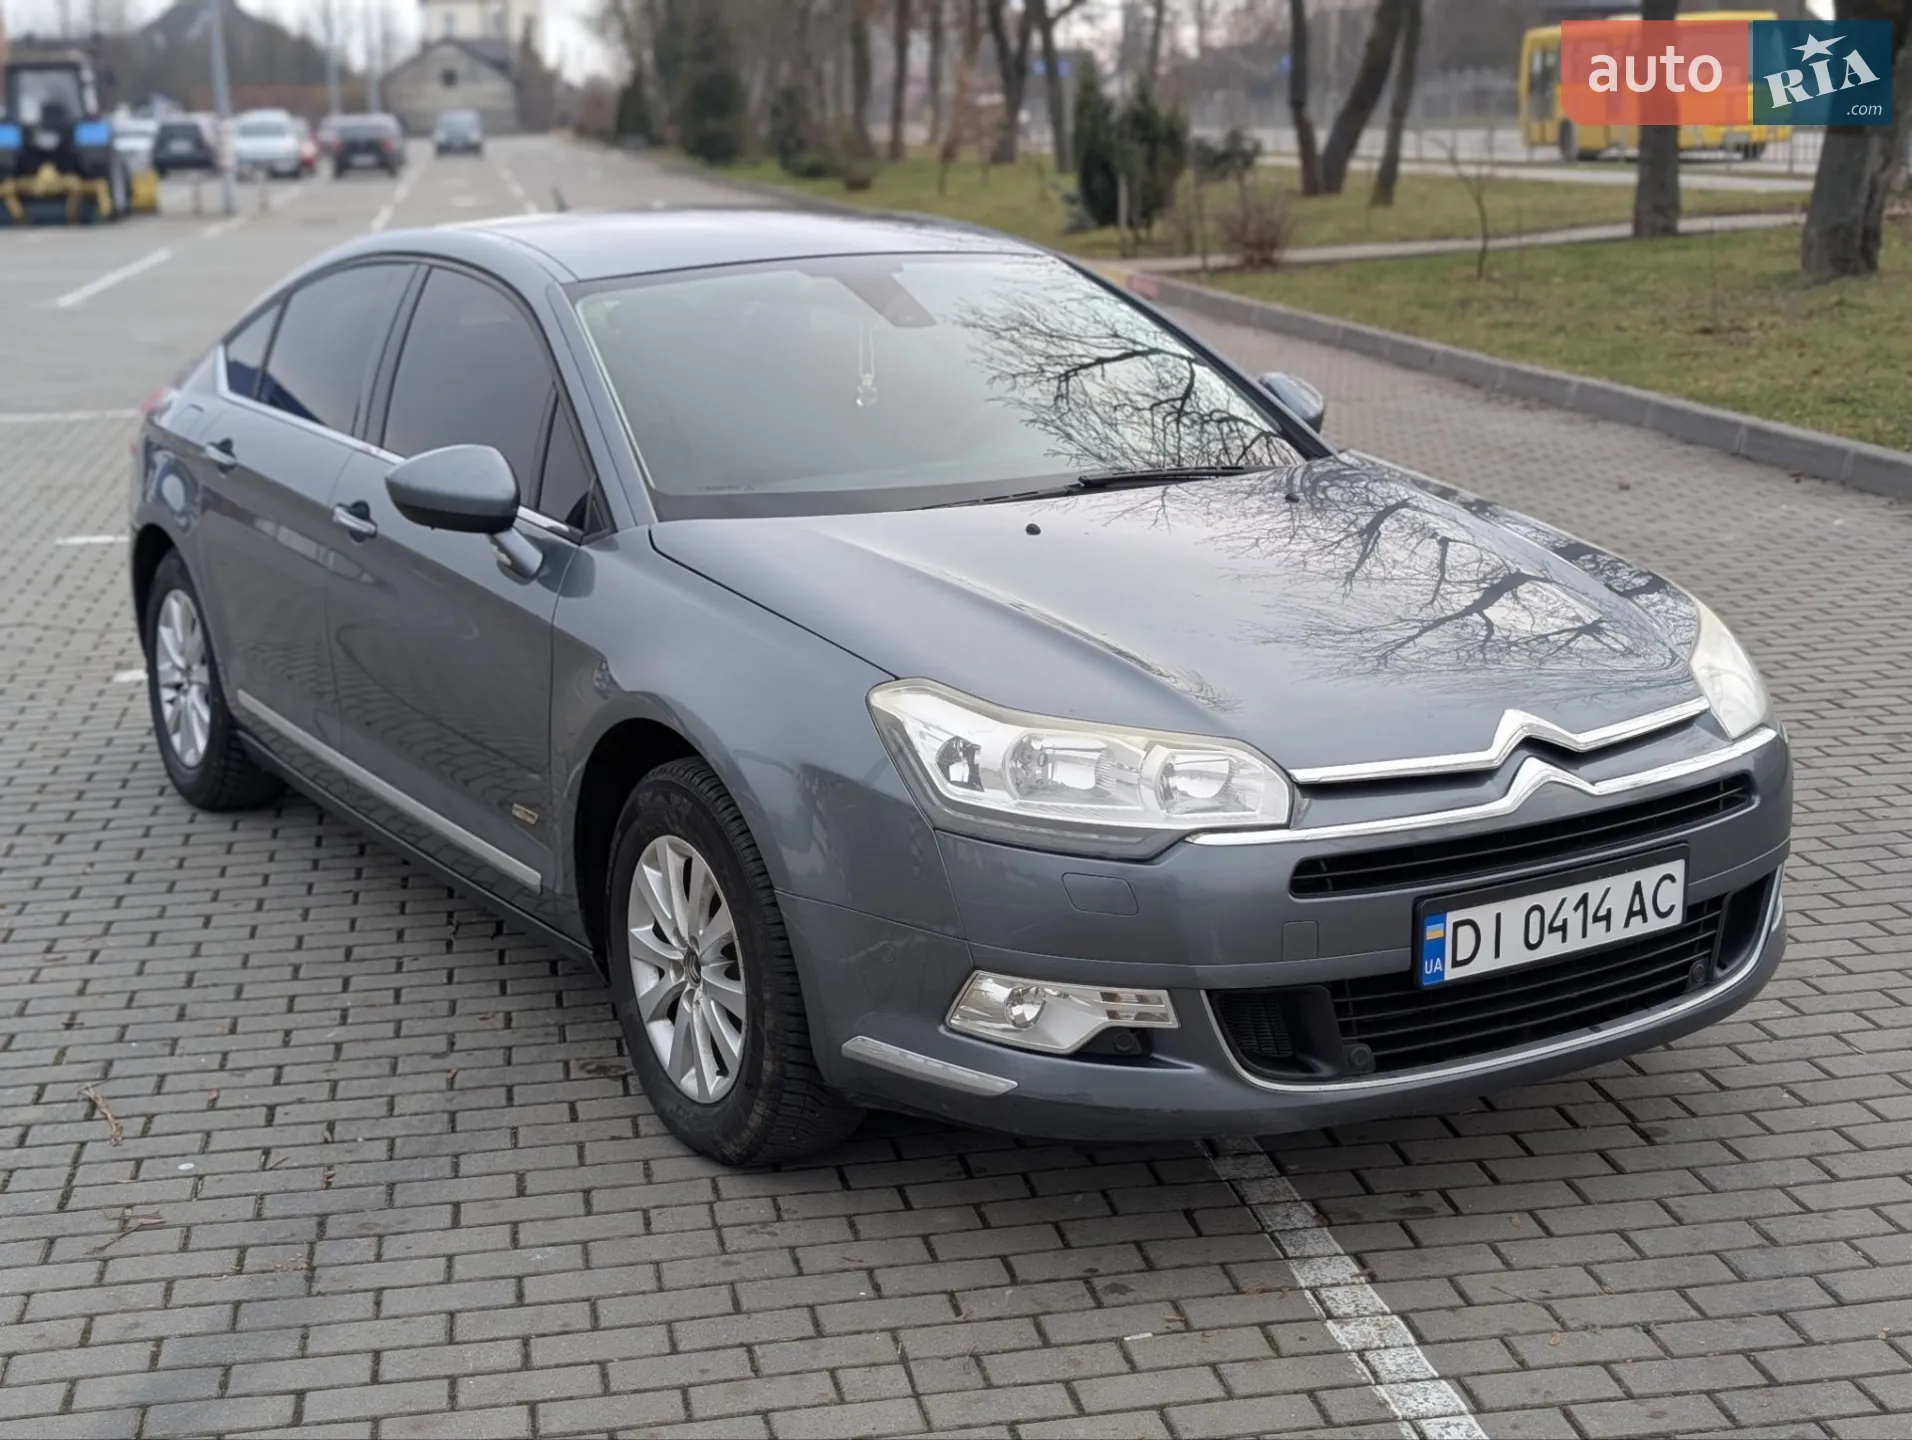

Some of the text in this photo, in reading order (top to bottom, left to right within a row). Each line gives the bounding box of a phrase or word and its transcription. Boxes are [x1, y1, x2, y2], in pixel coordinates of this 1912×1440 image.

[1451, 873, 1677, 969] DI 0414 AC
[1424, 957, 1443, 975] UA
